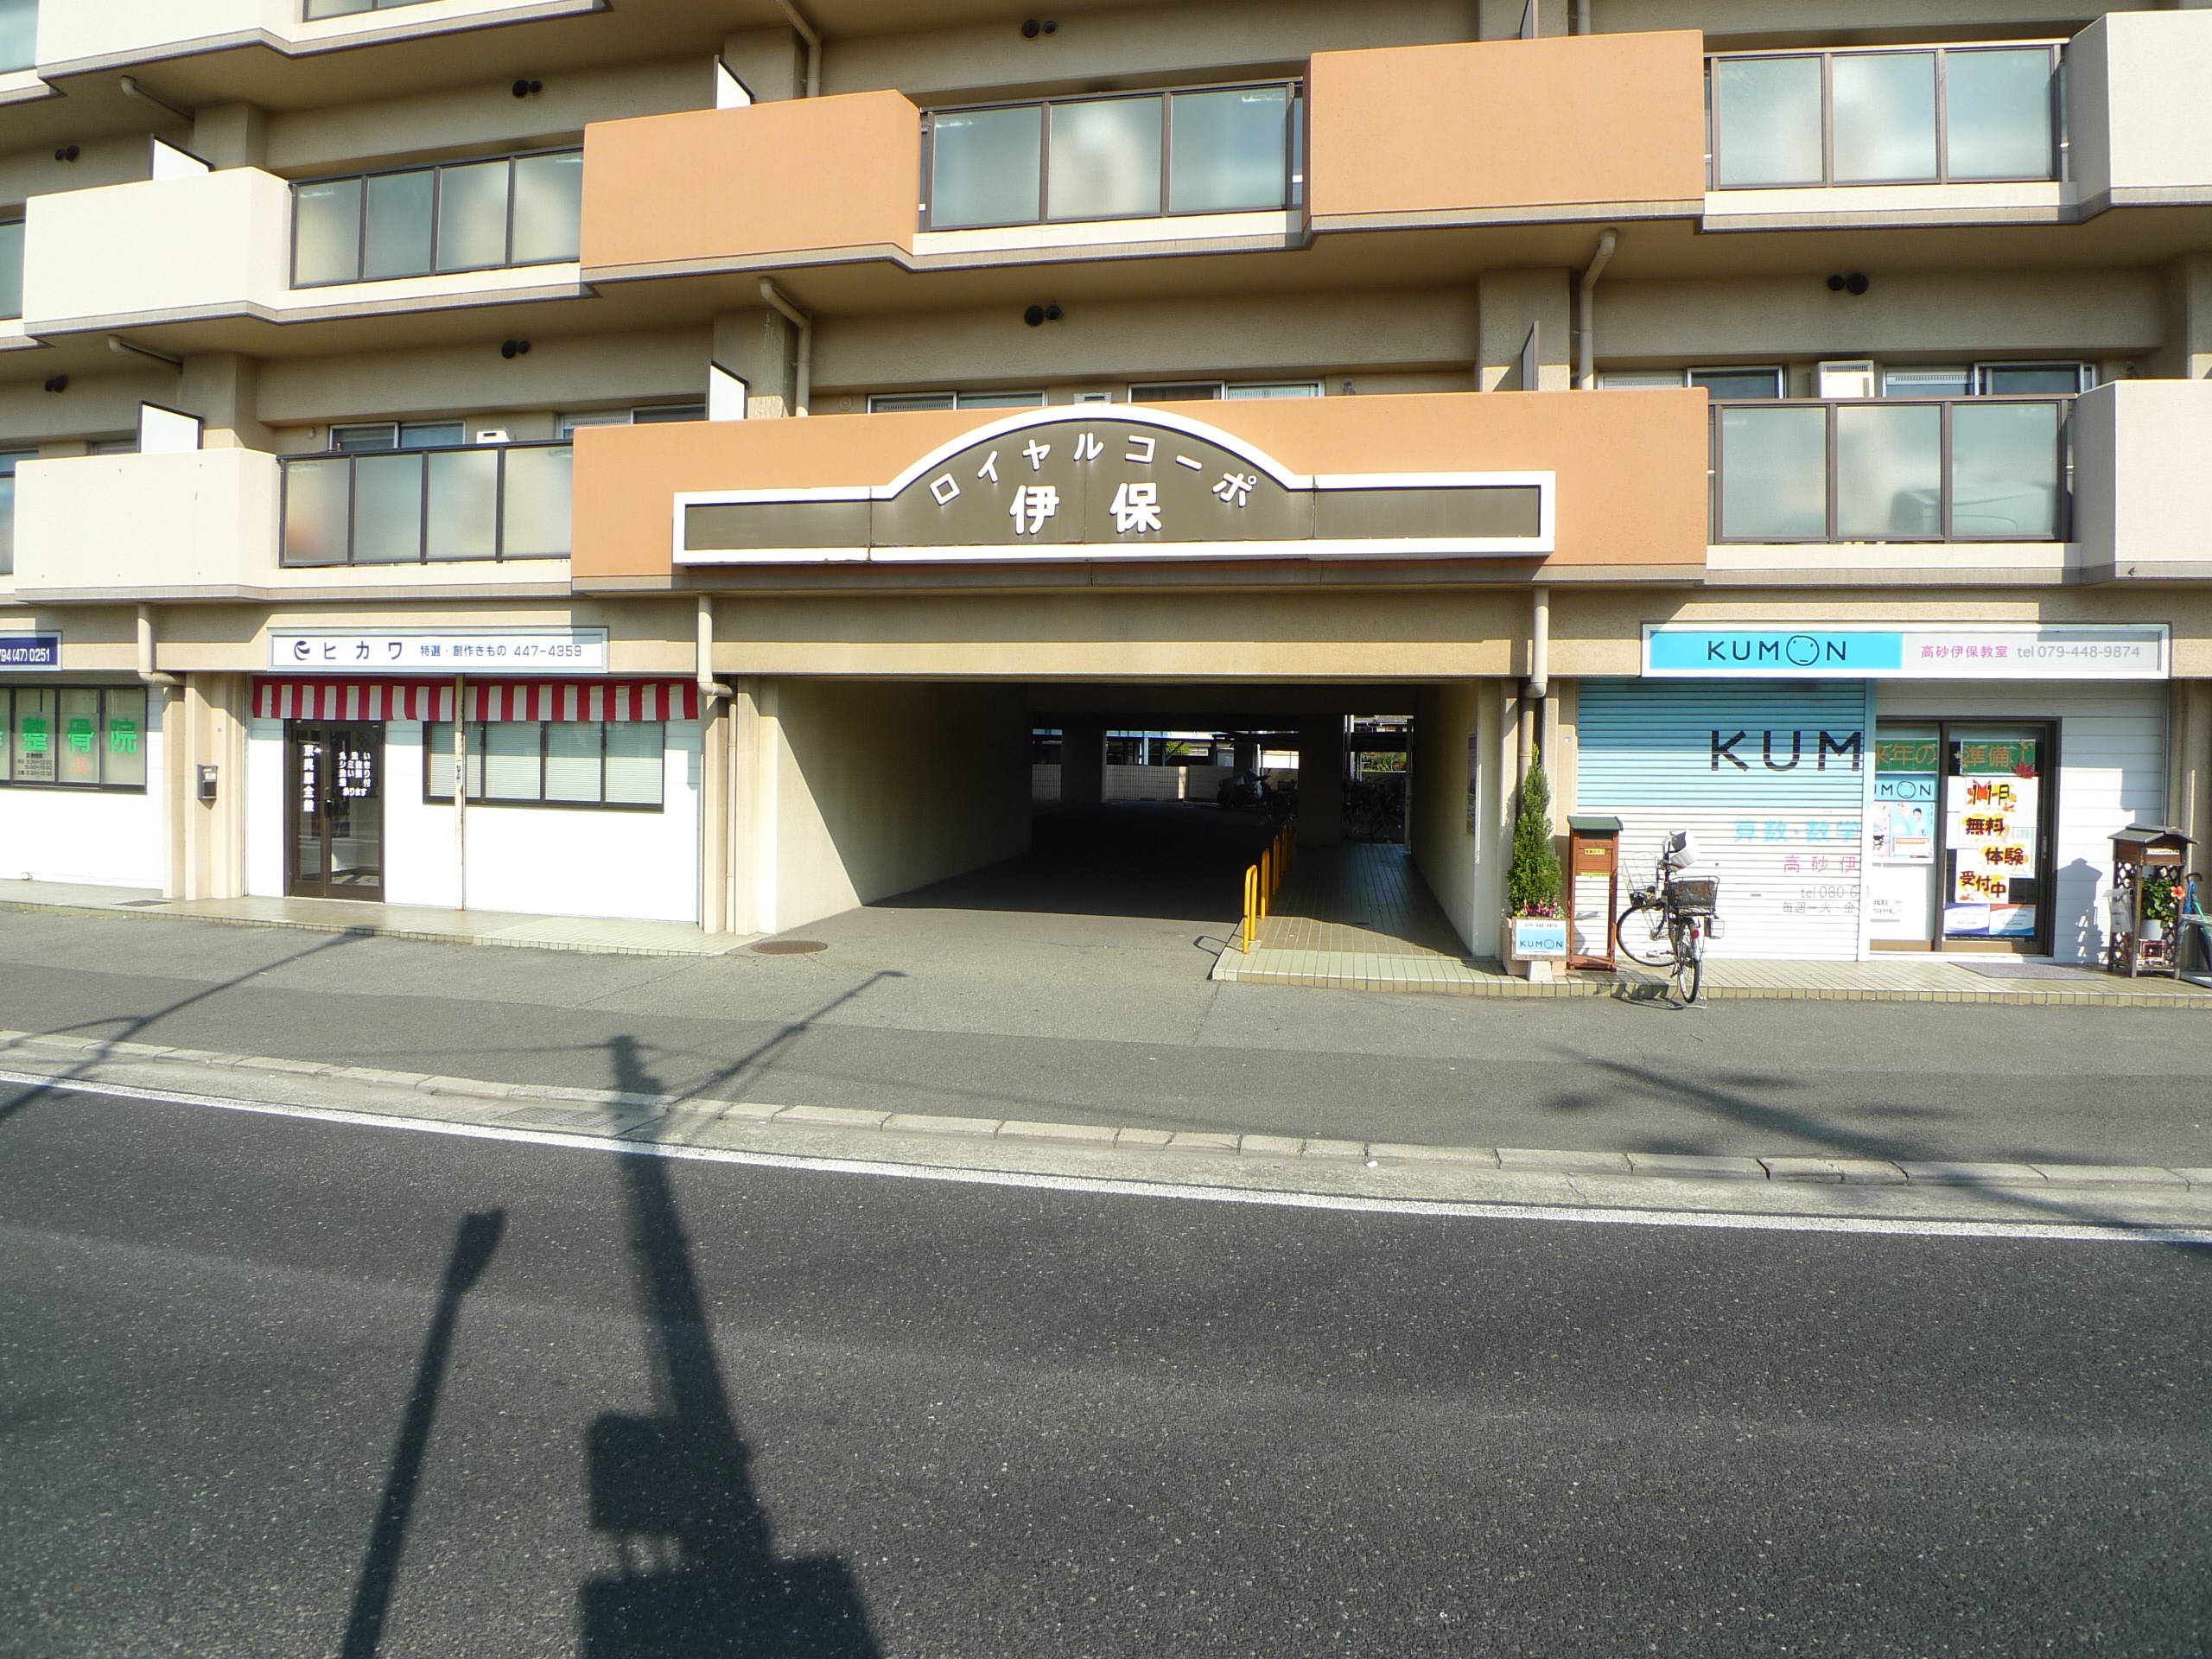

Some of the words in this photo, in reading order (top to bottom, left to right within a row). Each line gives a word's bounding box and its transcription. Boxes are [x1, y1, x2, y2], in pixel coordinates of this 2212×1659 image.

[929, 432, 1257, 506] ロイヤルコーポ
[1008, 483, 1162, 535] 伊保
[324, 640, 403, 660] ヒカワ
[514, 645, 582, 657] 447-4359
[1707, 635, 1847, 666] KUMON
[1921, 645, 2009, 658] 高砂伊保教室
[2018, 646, 2034, 658] tel
[2037, 646, 2140, 658] 079-448-9874
[0, 716, 138, 753] 整骨院
[1711, 729, 1862, 772] KUM
[1965, 817, 2005, 836] 無料
[1985, 847, 2024, 866] 体験
[1960, 870, 2007, 899] 受付中
[1520, 938, 1563, 950] KUMON
